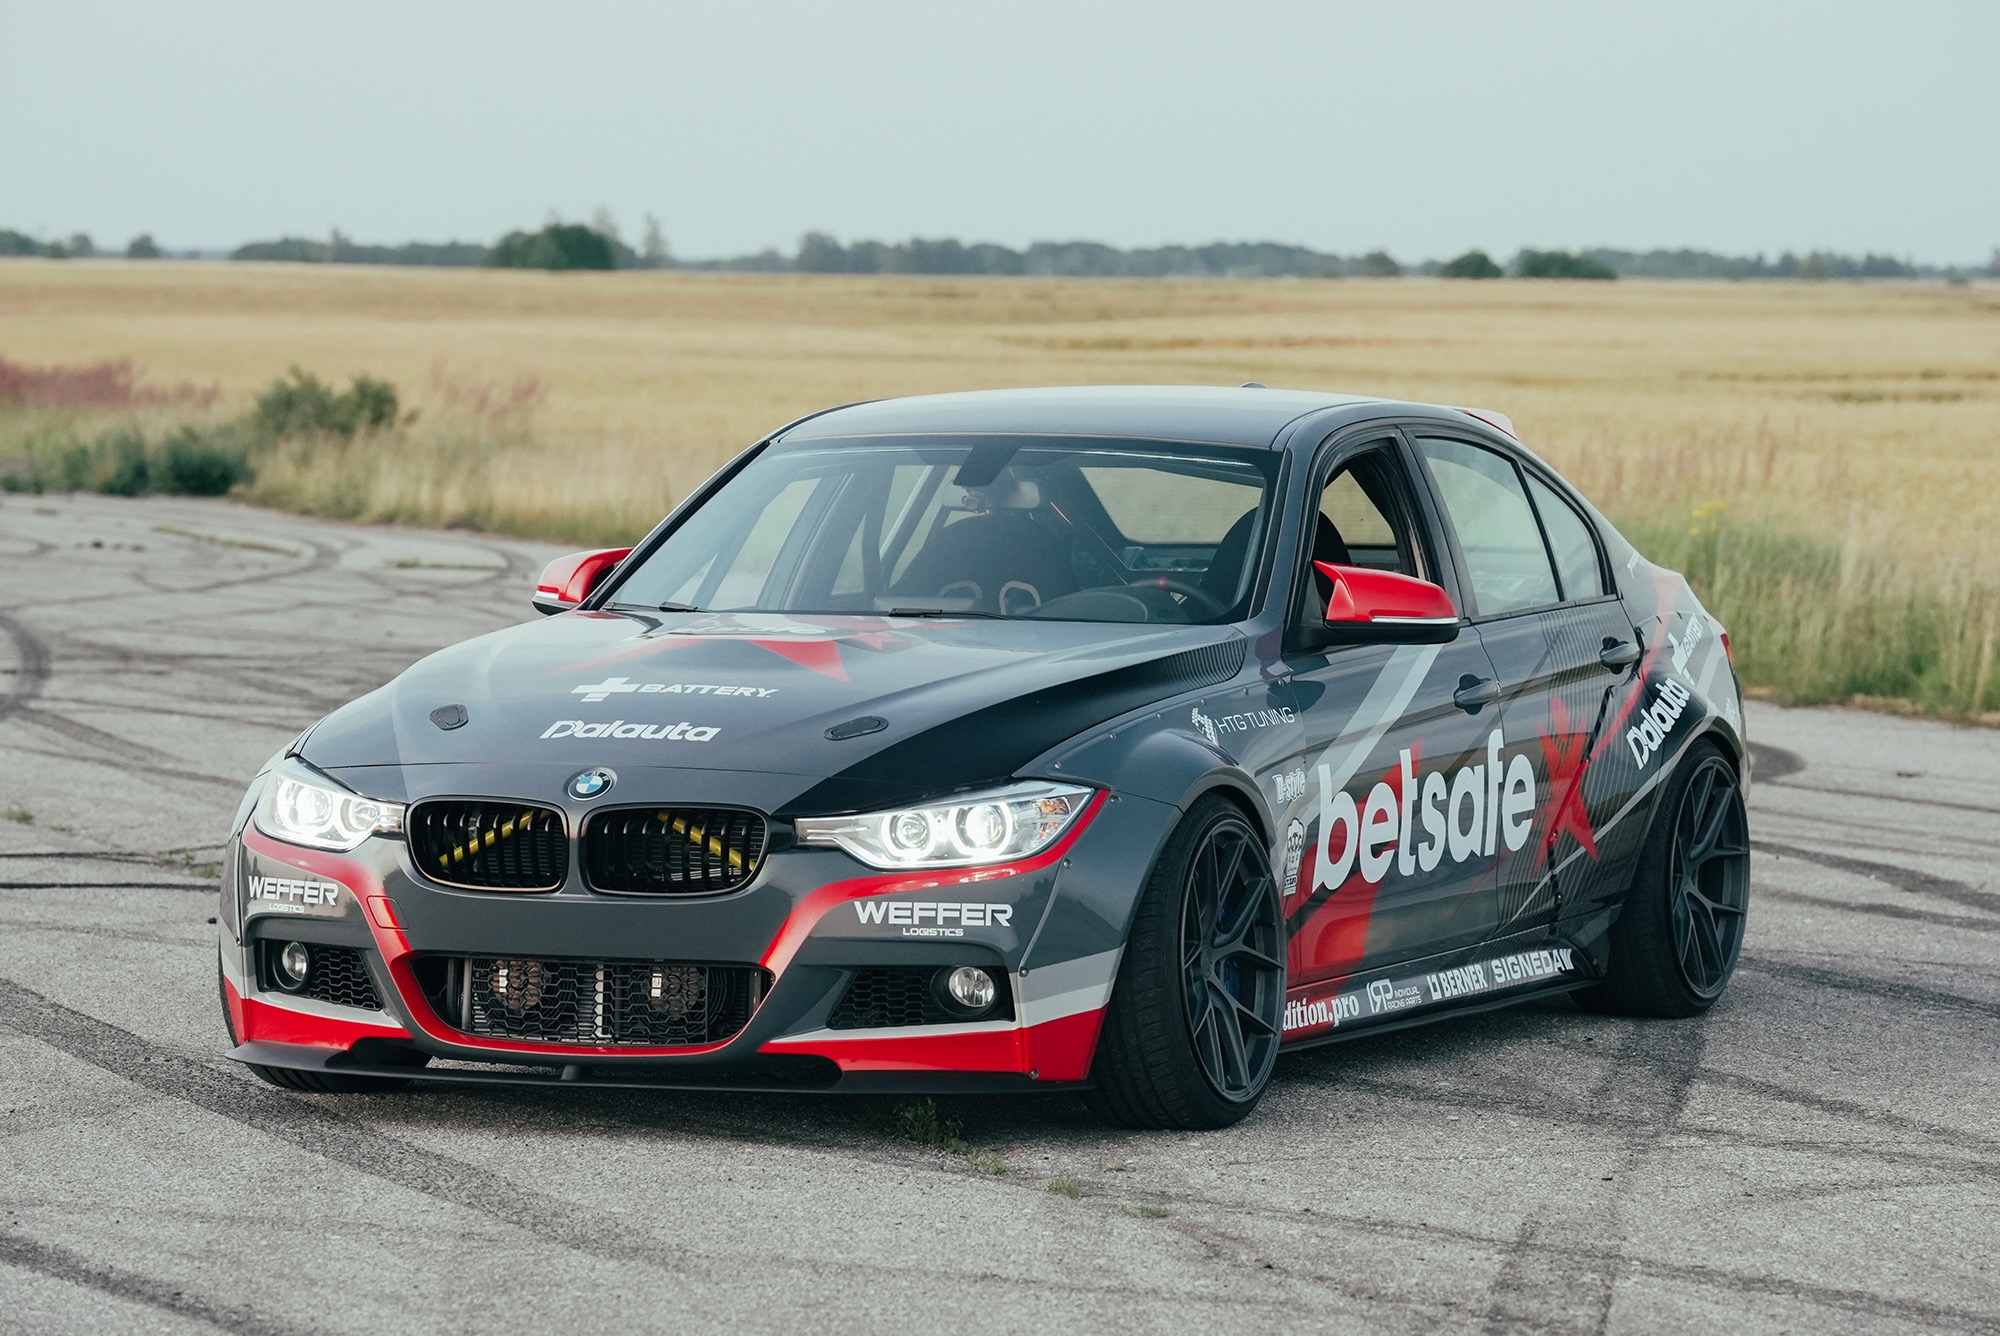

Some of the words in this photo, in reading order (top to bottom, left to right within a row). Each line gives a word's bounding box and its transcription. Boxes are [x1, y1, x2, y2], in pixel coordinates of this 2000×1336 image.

[539, 720, 722, 742] Dalauta
[1215, 714, 1247, 734] HTG
[1244, 707, 1295, 729] TUNING
[1626, 677, 1690, 770] Dalauta
[1312, 728, 1536, 893] betsafe
[248, 875, 339, 906] WEFFER
[268, 902, 305, 914] LOGISTICS
[854, 901, 1013, 927] WEFFER
[902, 927, 964, 937] LOGISTICS
[1439, 963, 1489, 998] BERNER
